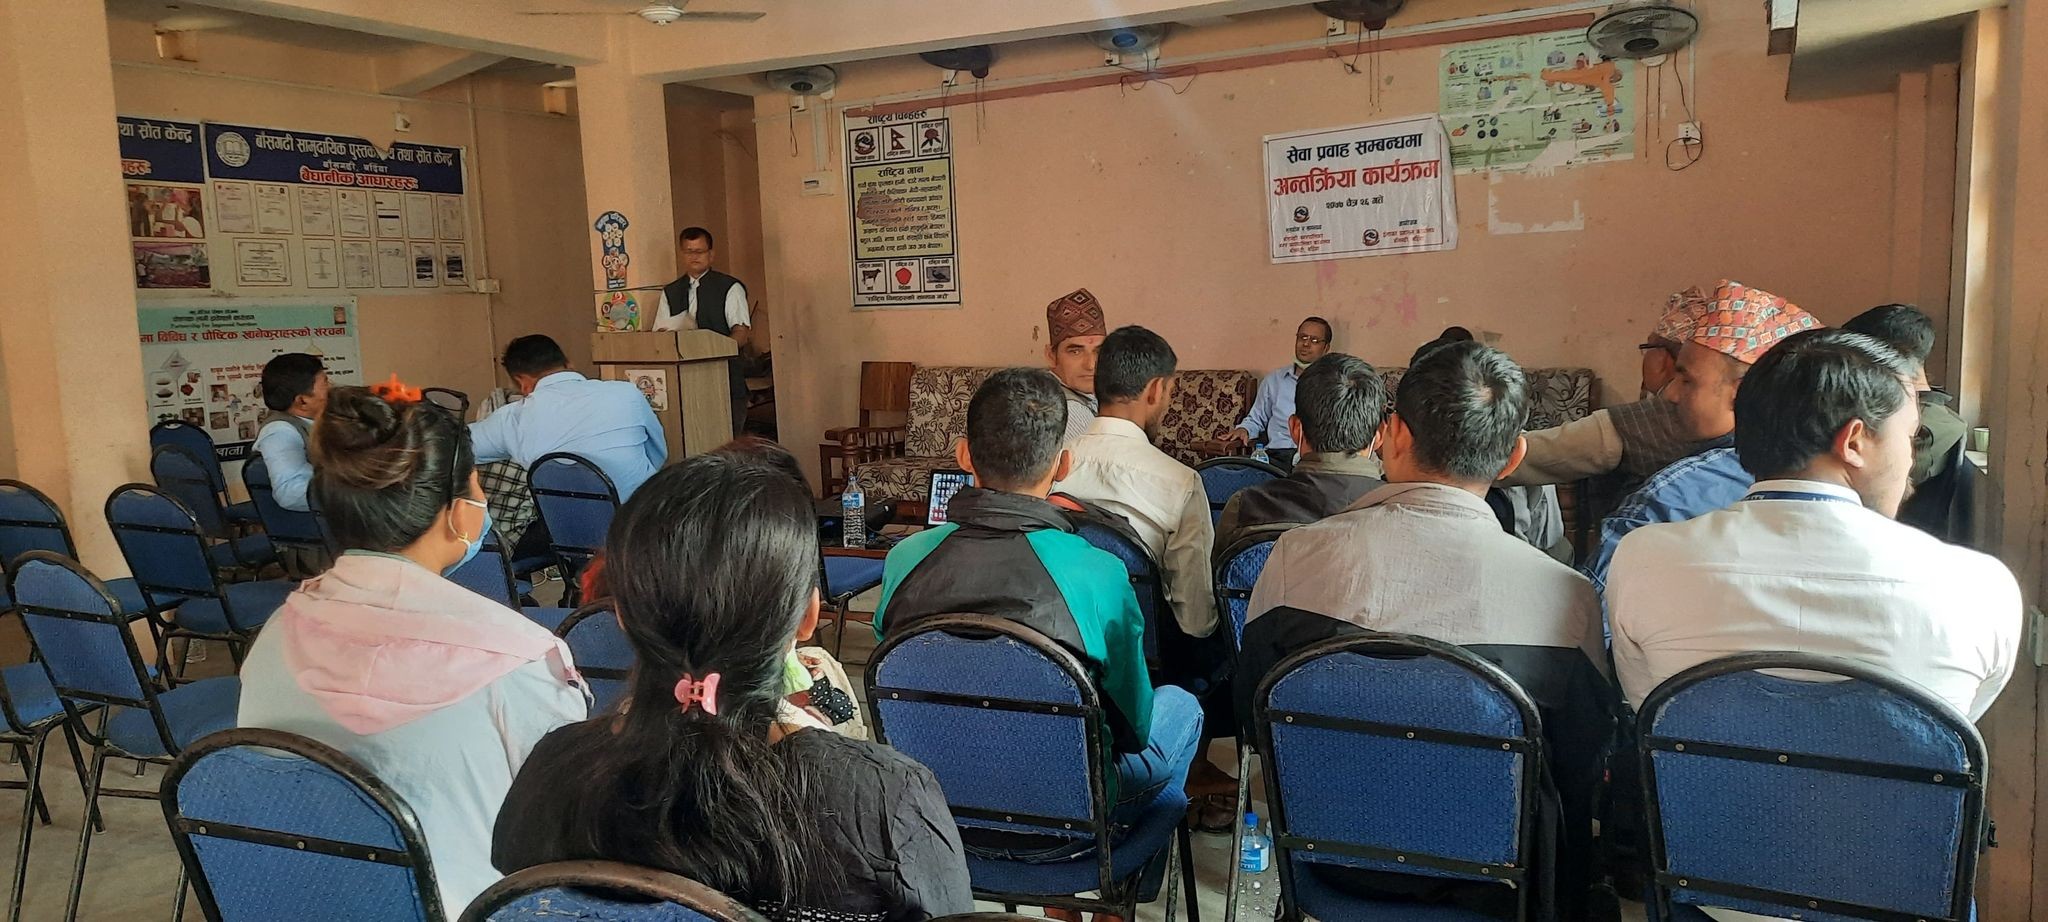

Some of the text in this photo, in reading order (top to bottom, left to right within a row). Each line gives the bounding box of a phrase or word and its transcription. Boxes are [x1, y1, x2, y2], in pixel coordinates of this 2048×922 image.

[164, 124, 193, 144] केन्द्र
[295, 137, 347, 158] सामुदायिक
[396, 148, 414, 163] तथा
[433, 149, 454, 167] केन्द्र
[1286, 133, 1424, 165] सेवा प्रवाह सम्बन्धमा
[877, 165, 924, 178] राष्ट्रिय गान
[1362, 158, 1441, 187] कार्यक्रम
[1359, 198, 1370, 206] २६
[1371, 194, 1385, 205] गते
